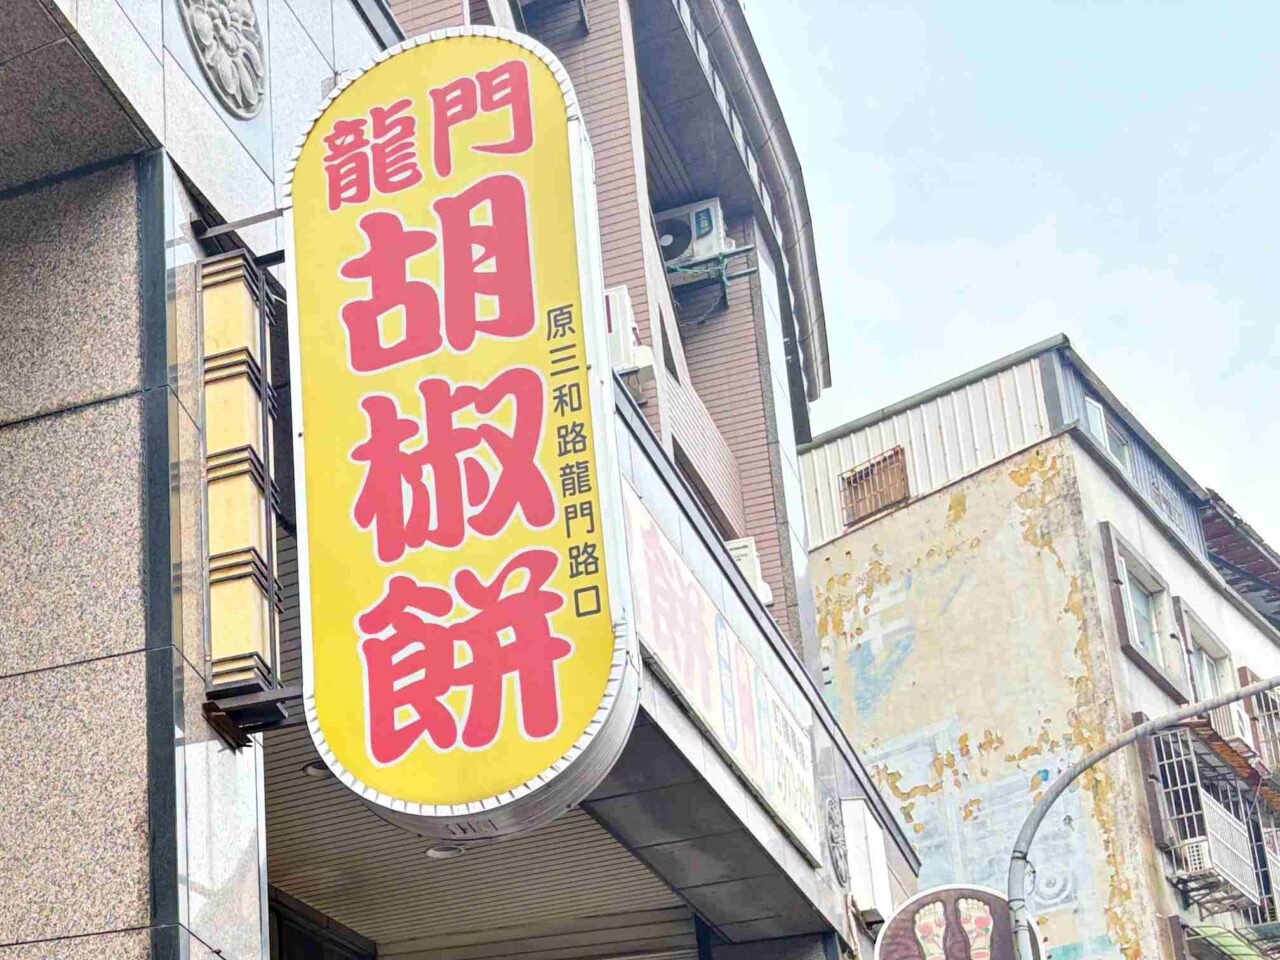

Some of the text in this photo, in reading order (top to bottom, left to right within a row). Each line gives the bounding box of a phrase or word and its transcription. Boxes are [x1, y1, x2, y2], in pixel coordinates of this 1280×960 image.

[323, 60, 534, 211] 龍門
[341, 175, 571, 764] 胡椒餅
[546, 303, 601, 618] 原三和路龍門路口
